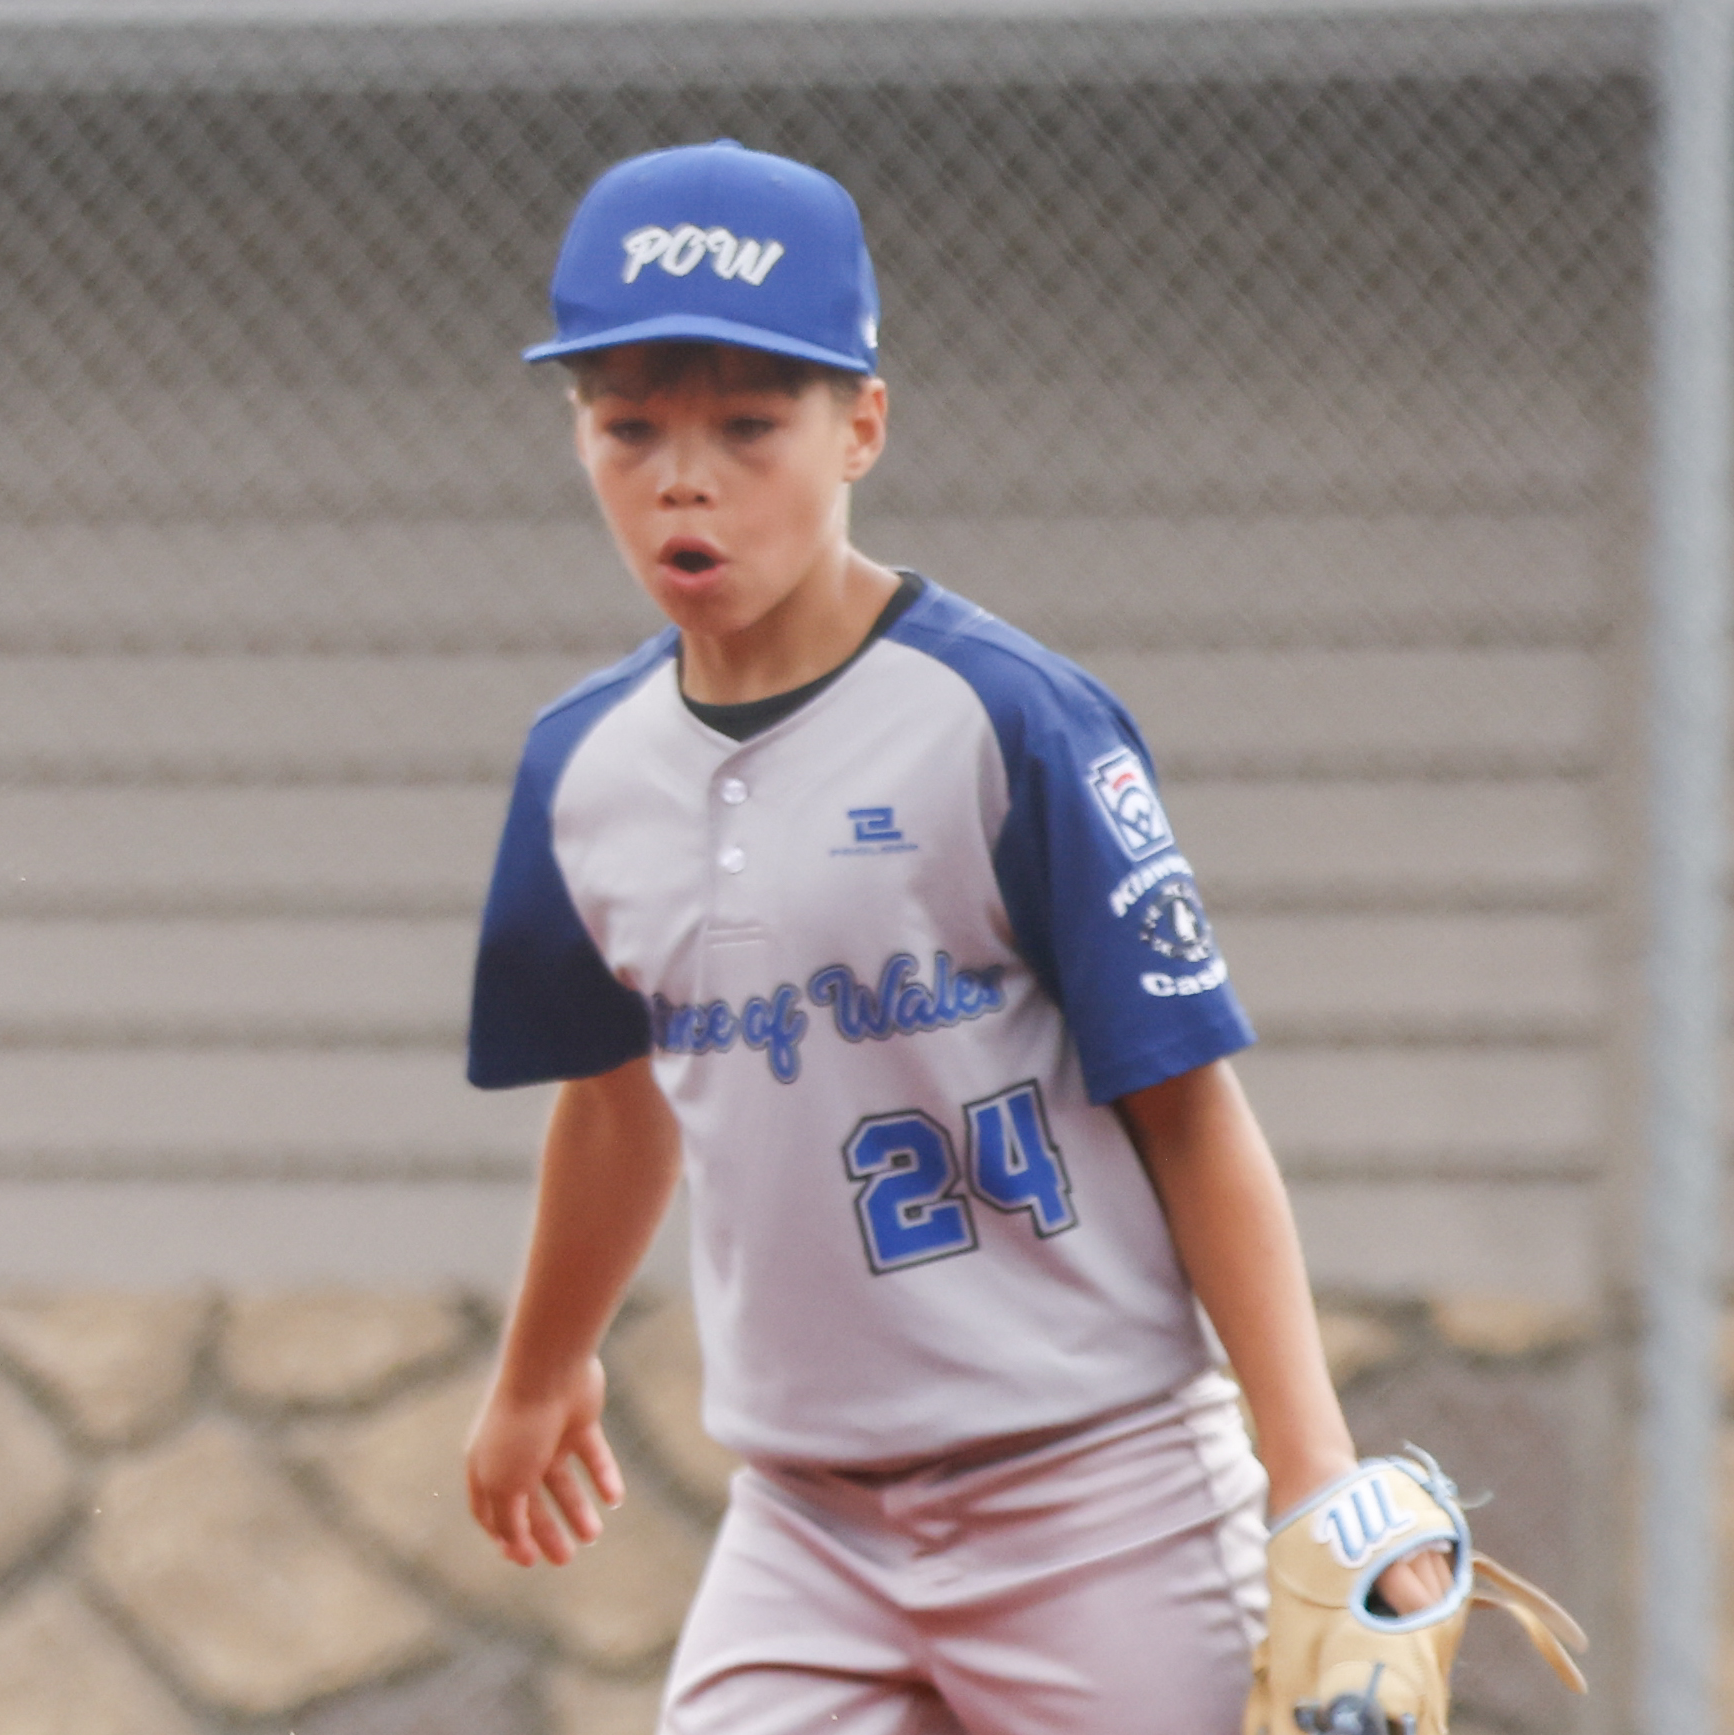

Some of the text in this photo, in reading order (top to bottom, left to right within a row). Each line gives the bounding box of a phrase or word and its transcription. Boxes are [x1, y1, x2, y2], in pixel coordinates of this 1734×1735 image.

[622, 223, 786, 287] POW
[741, 983, 811, 1085] of
[841, 1077, 1080, 1277] 24
